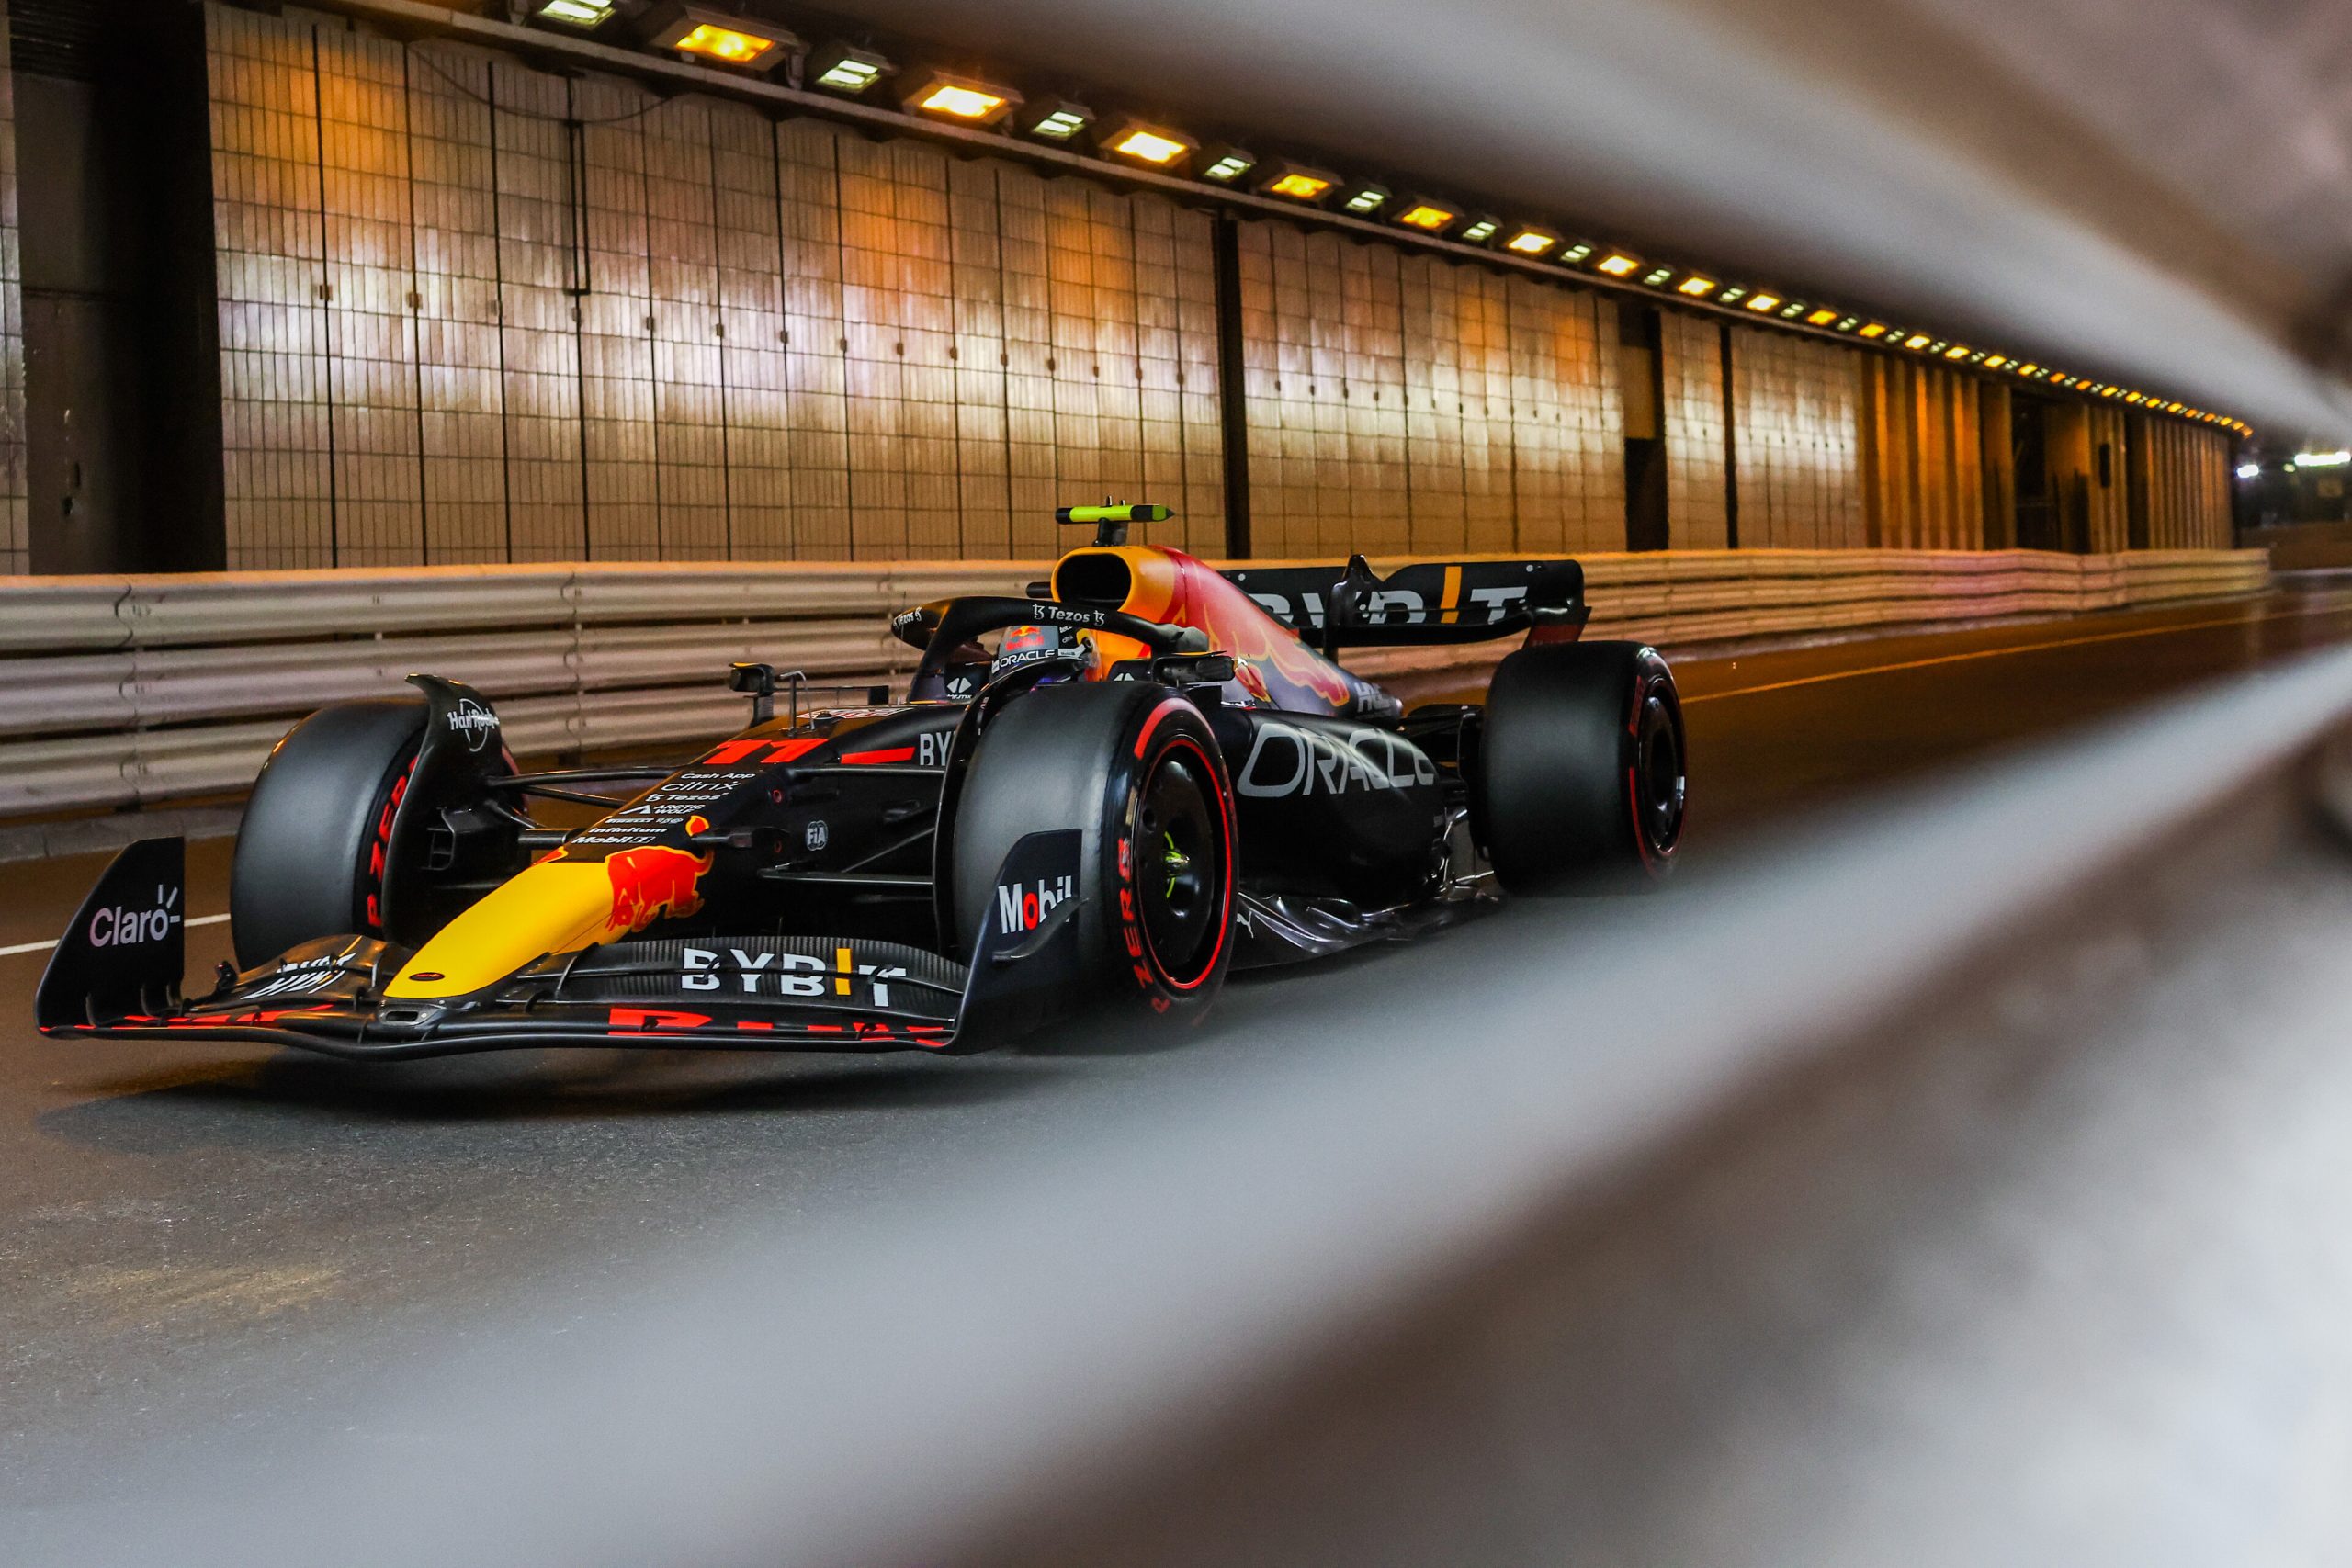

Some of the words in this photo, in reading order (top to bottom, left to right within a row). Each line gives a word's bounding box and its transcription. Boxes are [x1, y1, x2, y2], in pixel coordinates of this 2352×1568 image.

[1048, 606, 1091, 622] Tezos
[1000, 649, 1055, 668] ORACLE
[703, 738, 829, 764] 11
[920, 731, 956, 766] BY
[90, 906, 169, 948] Claro
[681, 947, 907, 1007] BYBIT
